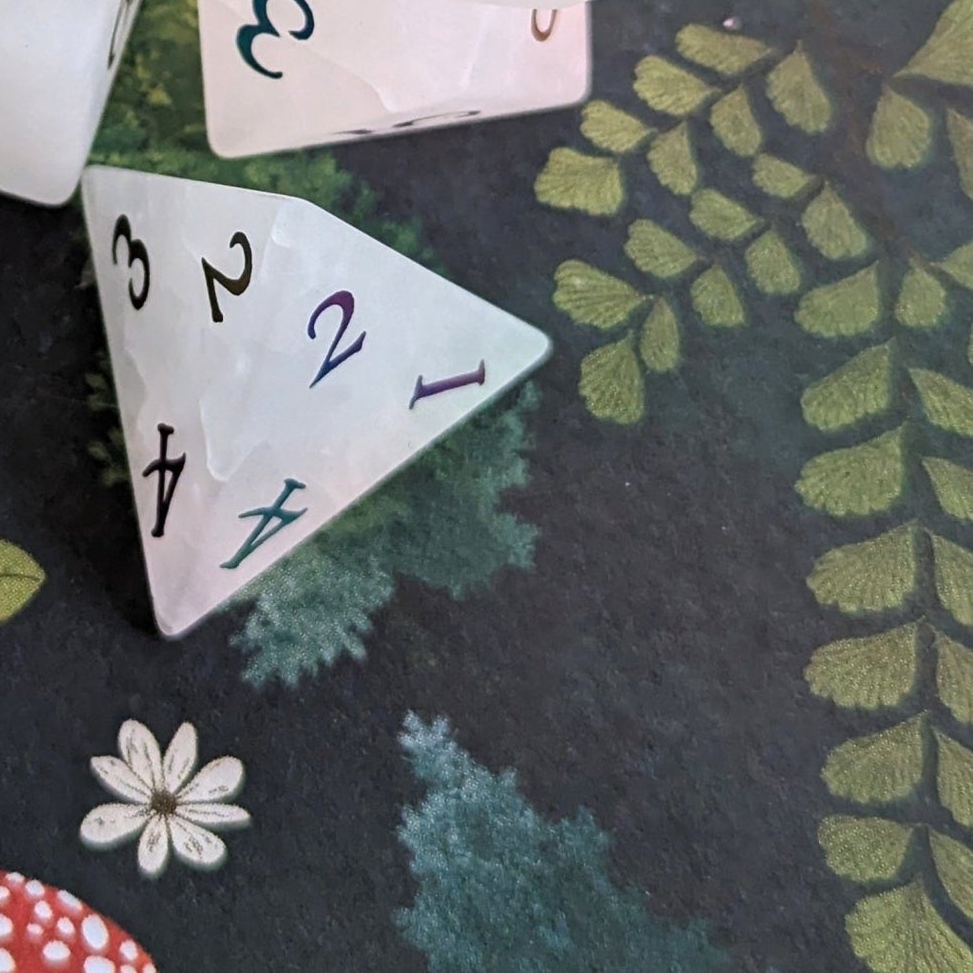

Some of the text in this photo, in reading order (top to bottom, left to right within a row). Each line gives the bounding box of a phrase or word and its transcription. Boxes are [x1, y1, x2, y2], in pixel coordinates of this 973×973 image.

[111, 214, 150, 311] 3
[201, 232, 253, 323] 2
[307, 290, 366, 389] 2
[409, 359, 486, 410] 1
[142, 423, 186, 538] 4
[220, 479, 307, 570] 4
